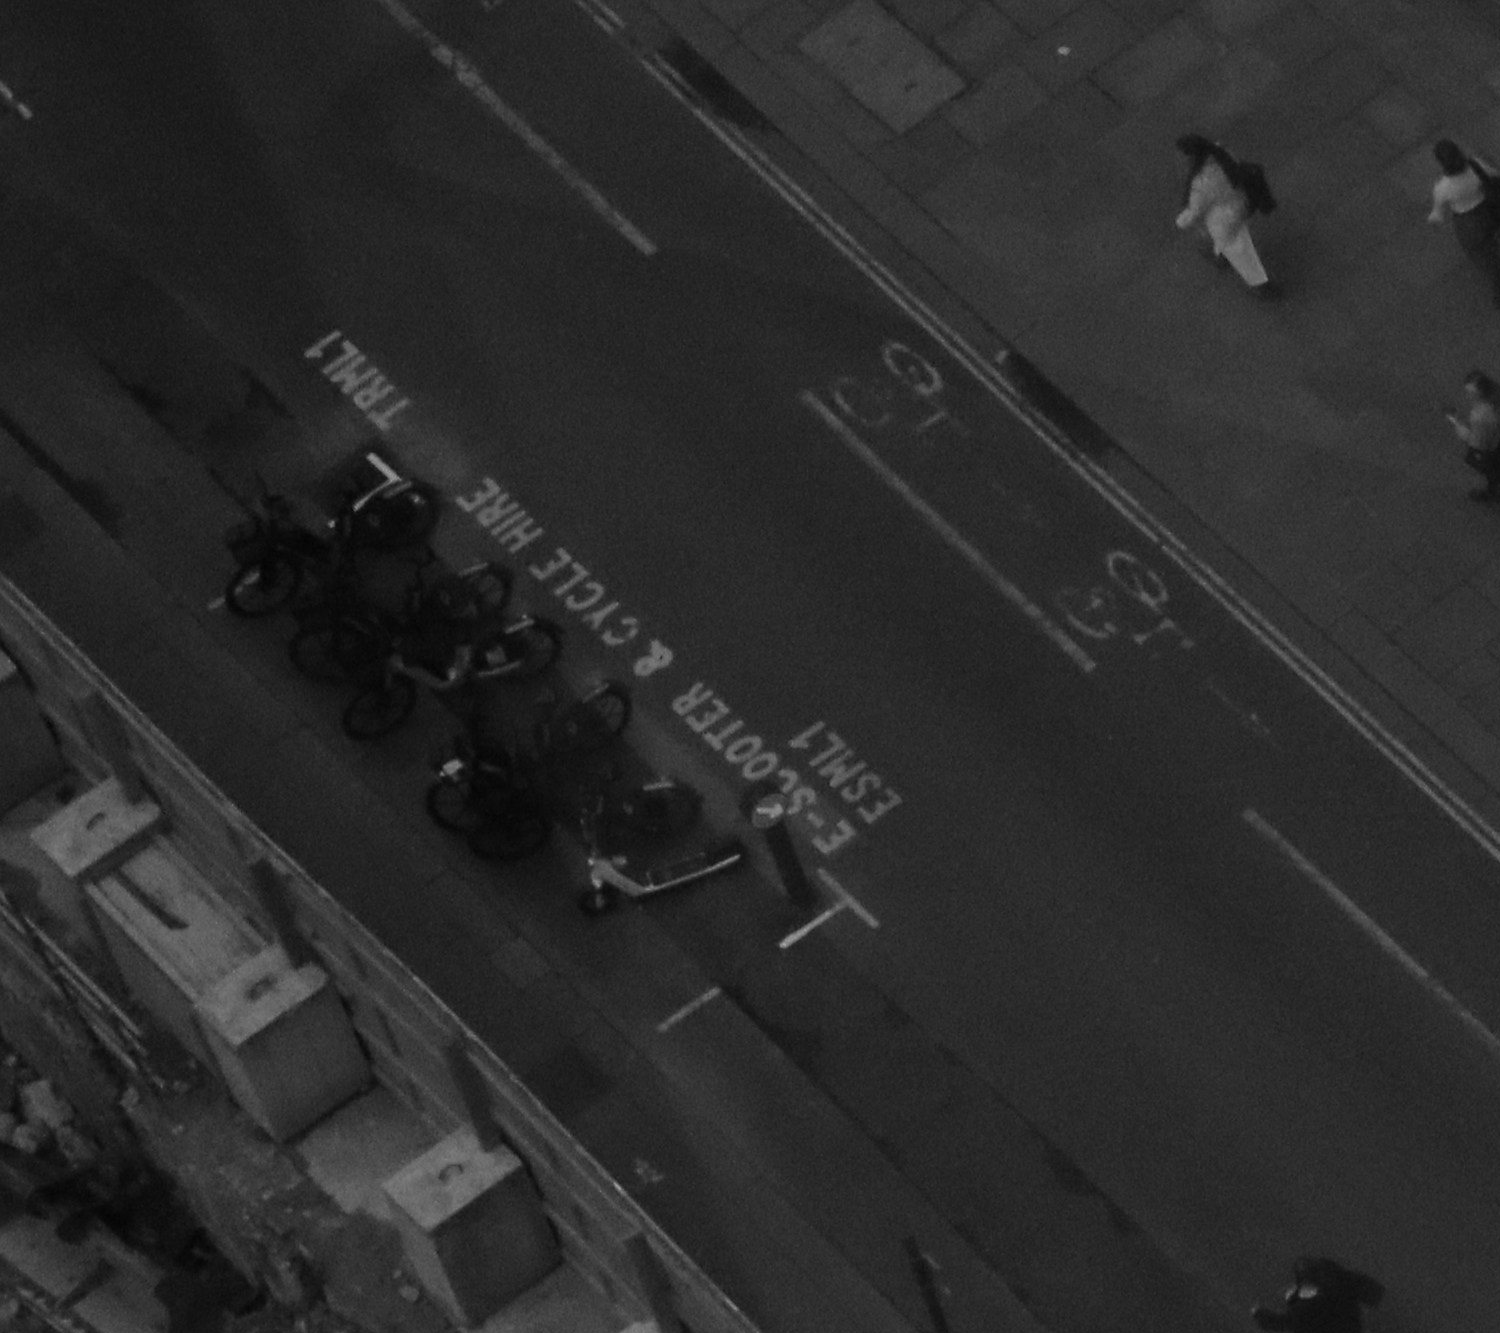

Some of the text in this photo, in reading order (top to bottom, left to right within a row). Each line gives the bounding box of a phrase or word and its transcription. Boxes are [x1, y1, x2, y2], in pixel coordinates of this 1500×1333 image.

[304, 329, 411, 433] TRML1
[455, 475, 545, 555] HIRE
[530, 546, 640, 647] CYCLE
[633, 639, 674, 677] &
[788, 720, 904, 825] ESML1
